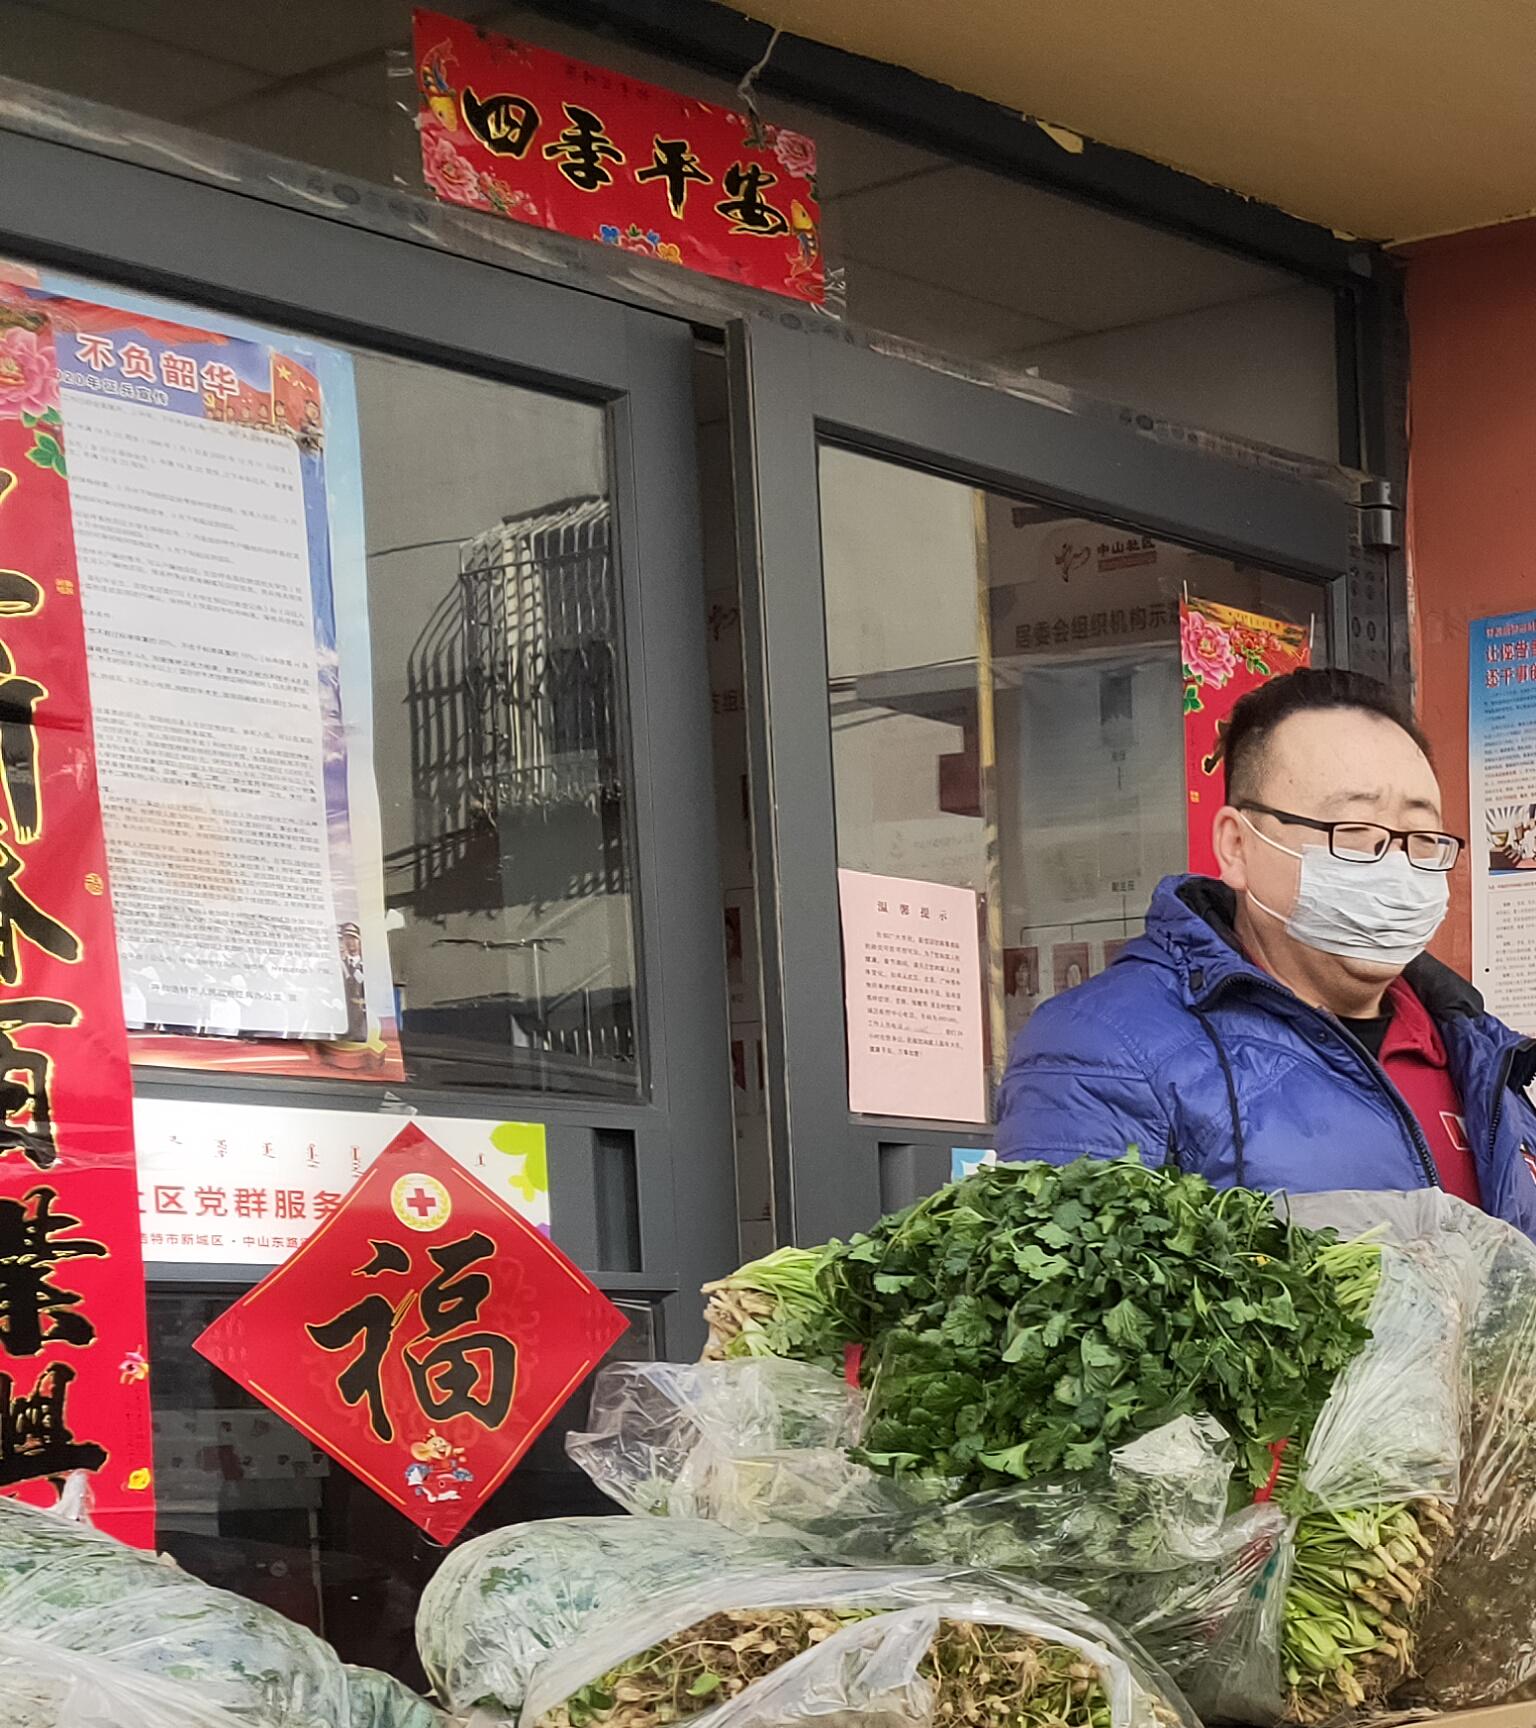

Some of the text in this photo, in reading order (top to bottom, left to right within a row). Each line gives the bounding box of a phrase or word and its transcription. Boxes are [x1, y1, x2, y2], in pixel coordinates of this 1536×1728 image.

[461, 87, 790, 235] 四季平安
[76, 333, 241, 398] 不负韶华
[1097, 537, 1156, 556] 中山社区
[877, 900, 948, 921] 温馨提示
[306, 1231, 517, 1443] 福
